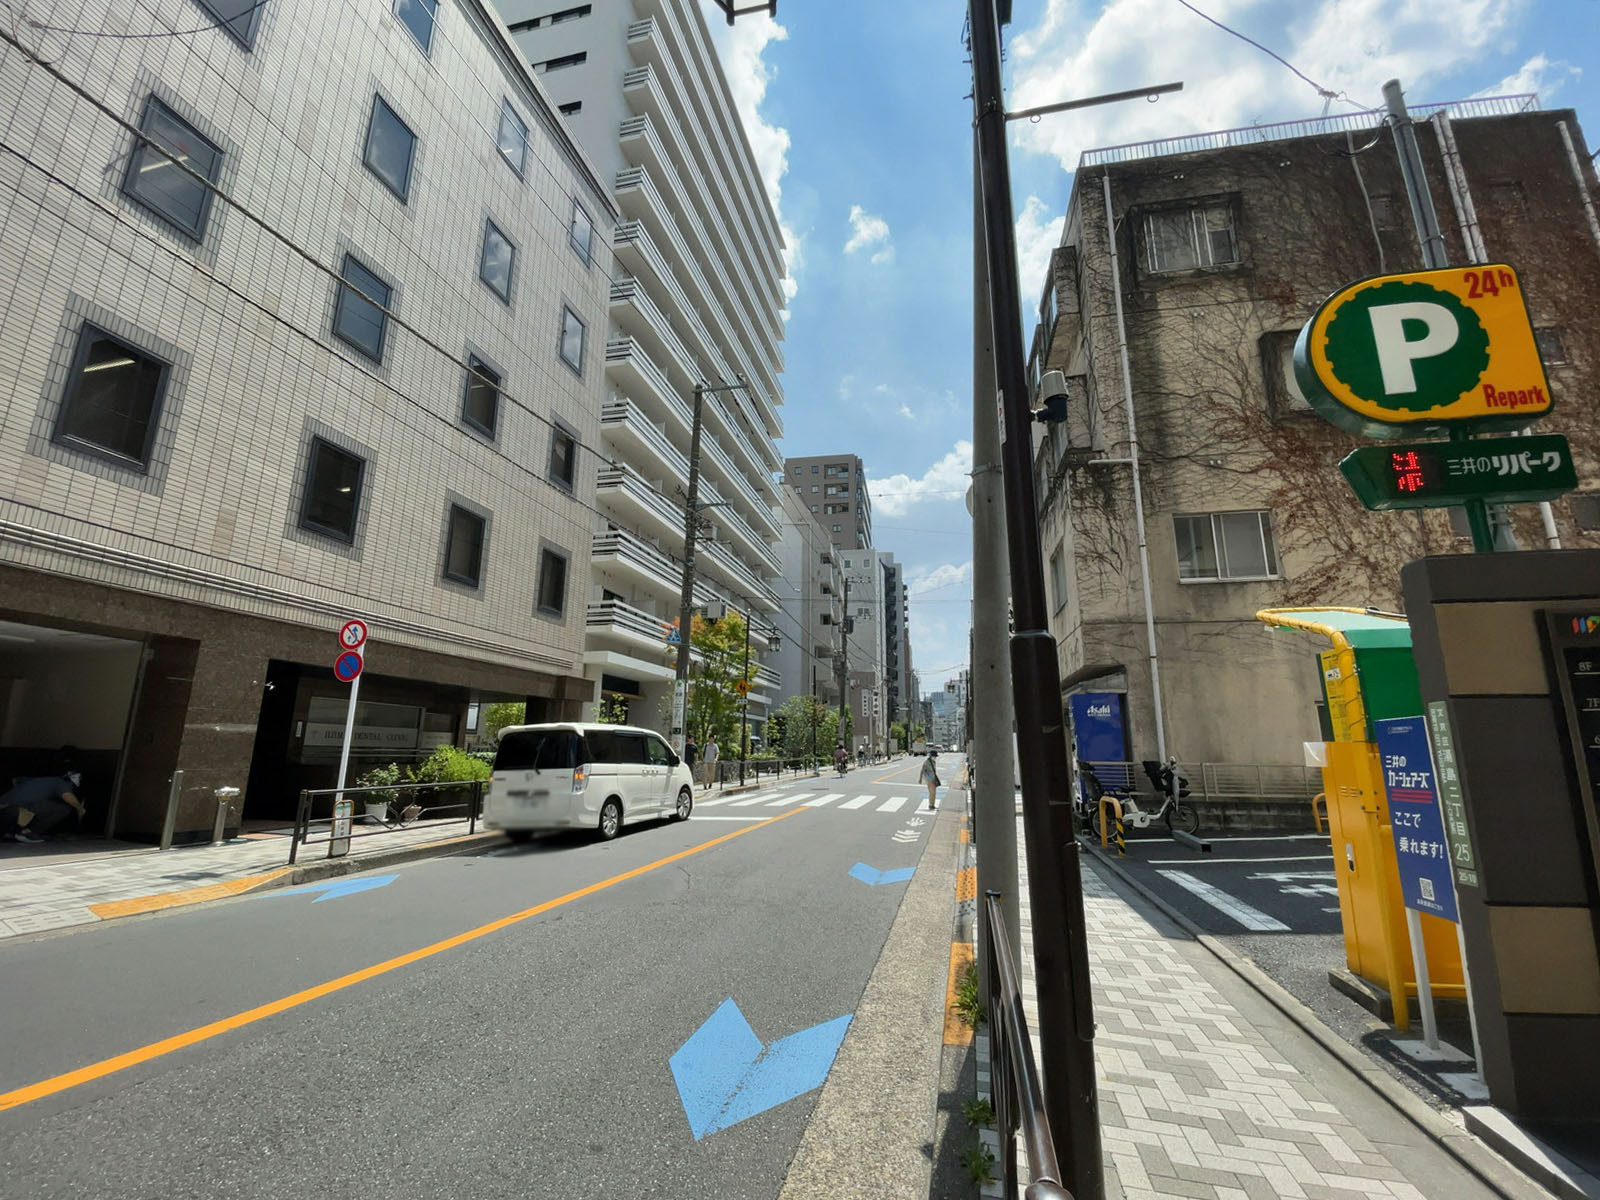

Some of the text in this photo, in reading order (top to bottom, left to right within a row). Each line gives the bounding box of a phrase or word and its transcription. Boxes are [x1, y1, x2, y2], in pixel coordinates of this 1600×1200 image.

[1463, 269, 1515, 299] 24h
[1368, 301, 1460, 395] P
[1482, 384, 1547, 409] Repark
[1446, 451, 1562, 477] 三井のリパーク
[1578, 661, 1593, 671] 8F
[1385, 755, 1407, 768] 三井の
[1394, 811, 1422, 828] ここで
[1454, 843, 1471, 862] 25
